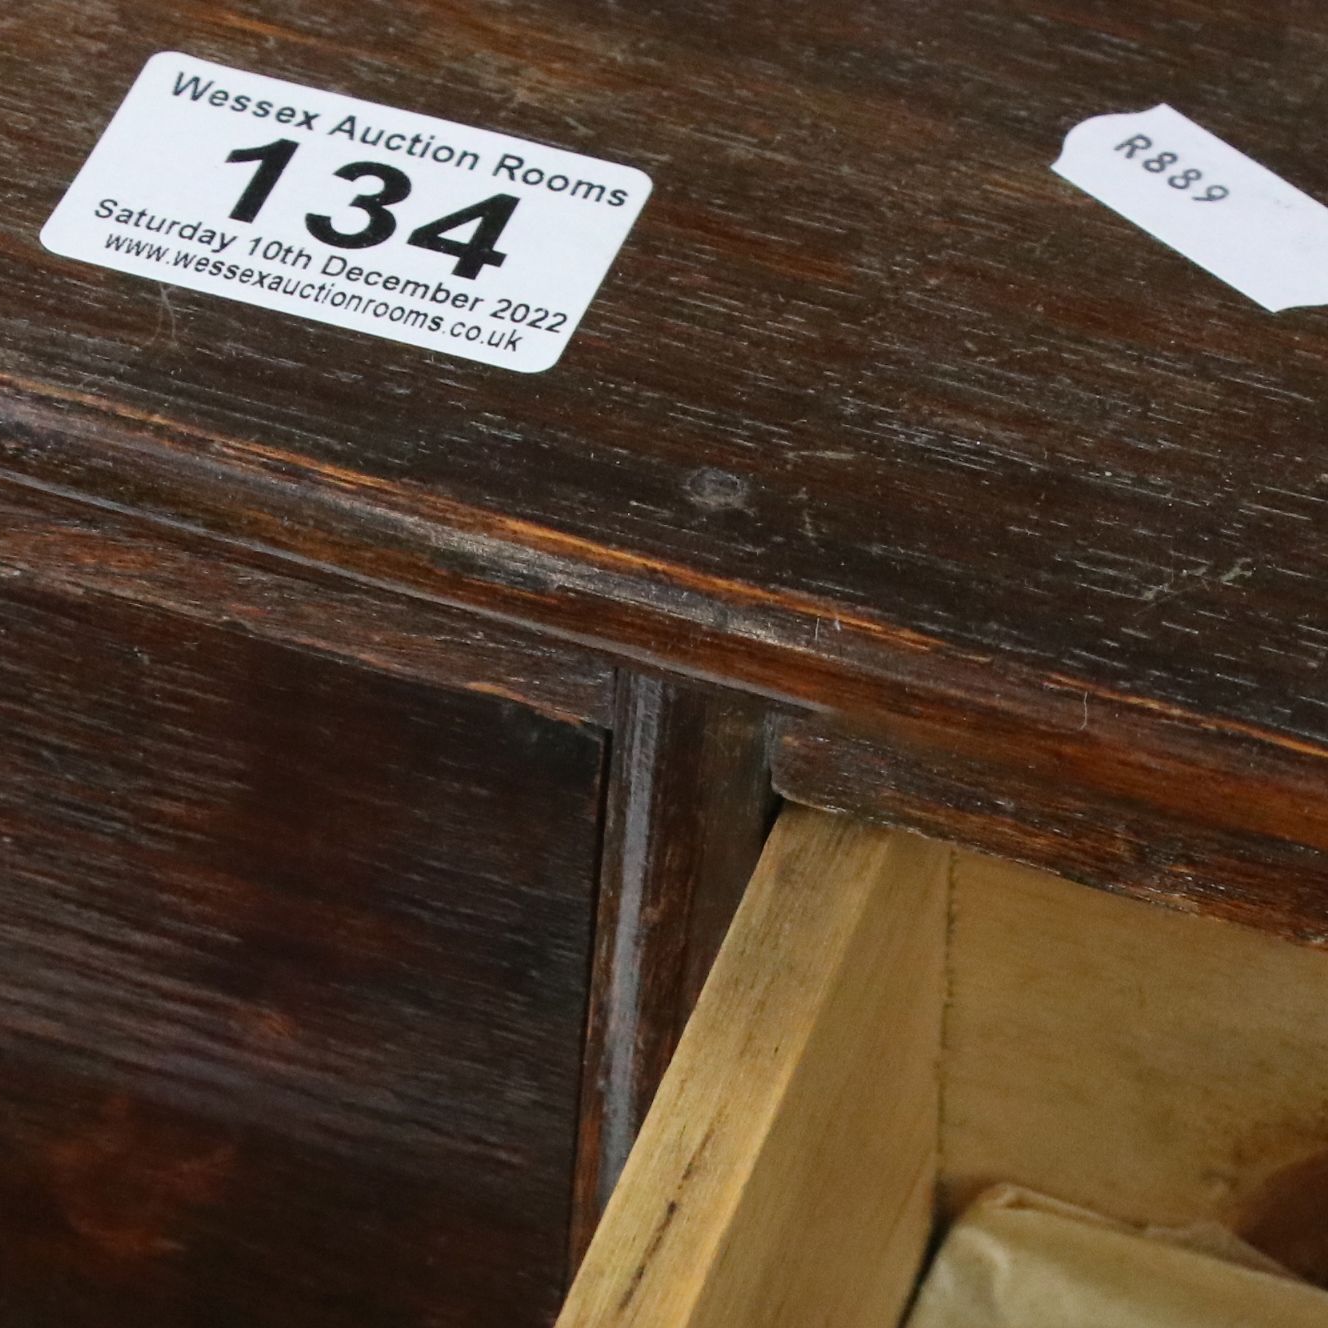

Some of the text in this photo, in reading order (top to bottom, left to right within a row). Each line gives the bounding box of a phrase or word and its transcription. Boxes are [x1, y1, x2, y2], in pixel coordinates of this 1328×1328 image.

[171, 71, 630, 208] Wessex Auction Rooms
[1113, 133, 1230, 203] R889
[93, 197, 569, 335] Saturday 10th December 2022
[224, 137, 523, 282] 134
[104, 233, 524, 353] www.wessexauctionrooms.co.uk
